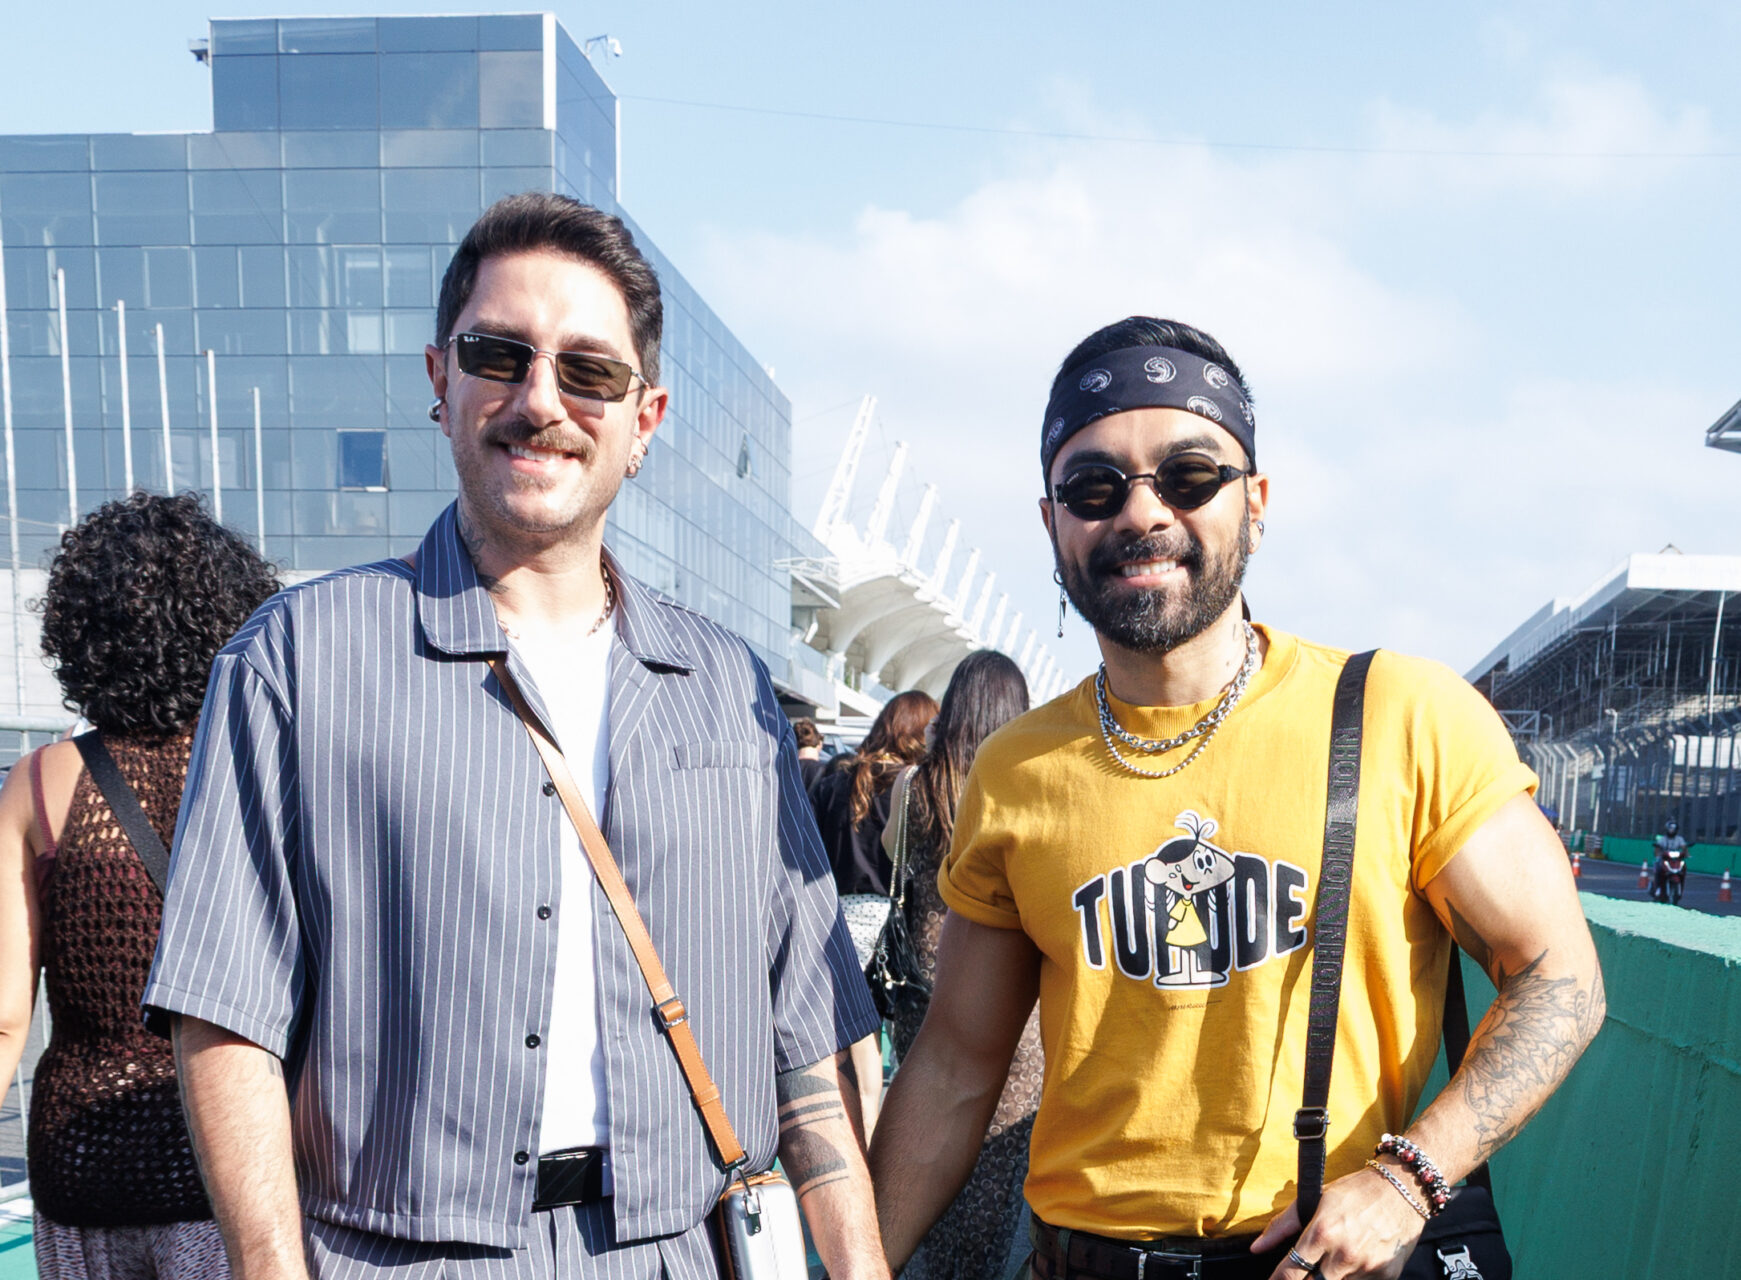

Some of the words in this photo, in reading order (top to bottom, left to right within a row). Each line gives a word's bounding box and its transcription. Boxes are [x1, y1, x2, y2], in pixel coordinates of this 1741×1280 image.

[1331, 726, 1360, 800] JOHN
[1322, 820, 1354, 901] JOHN
[1313, 922, 1345, 1003] JOHN
